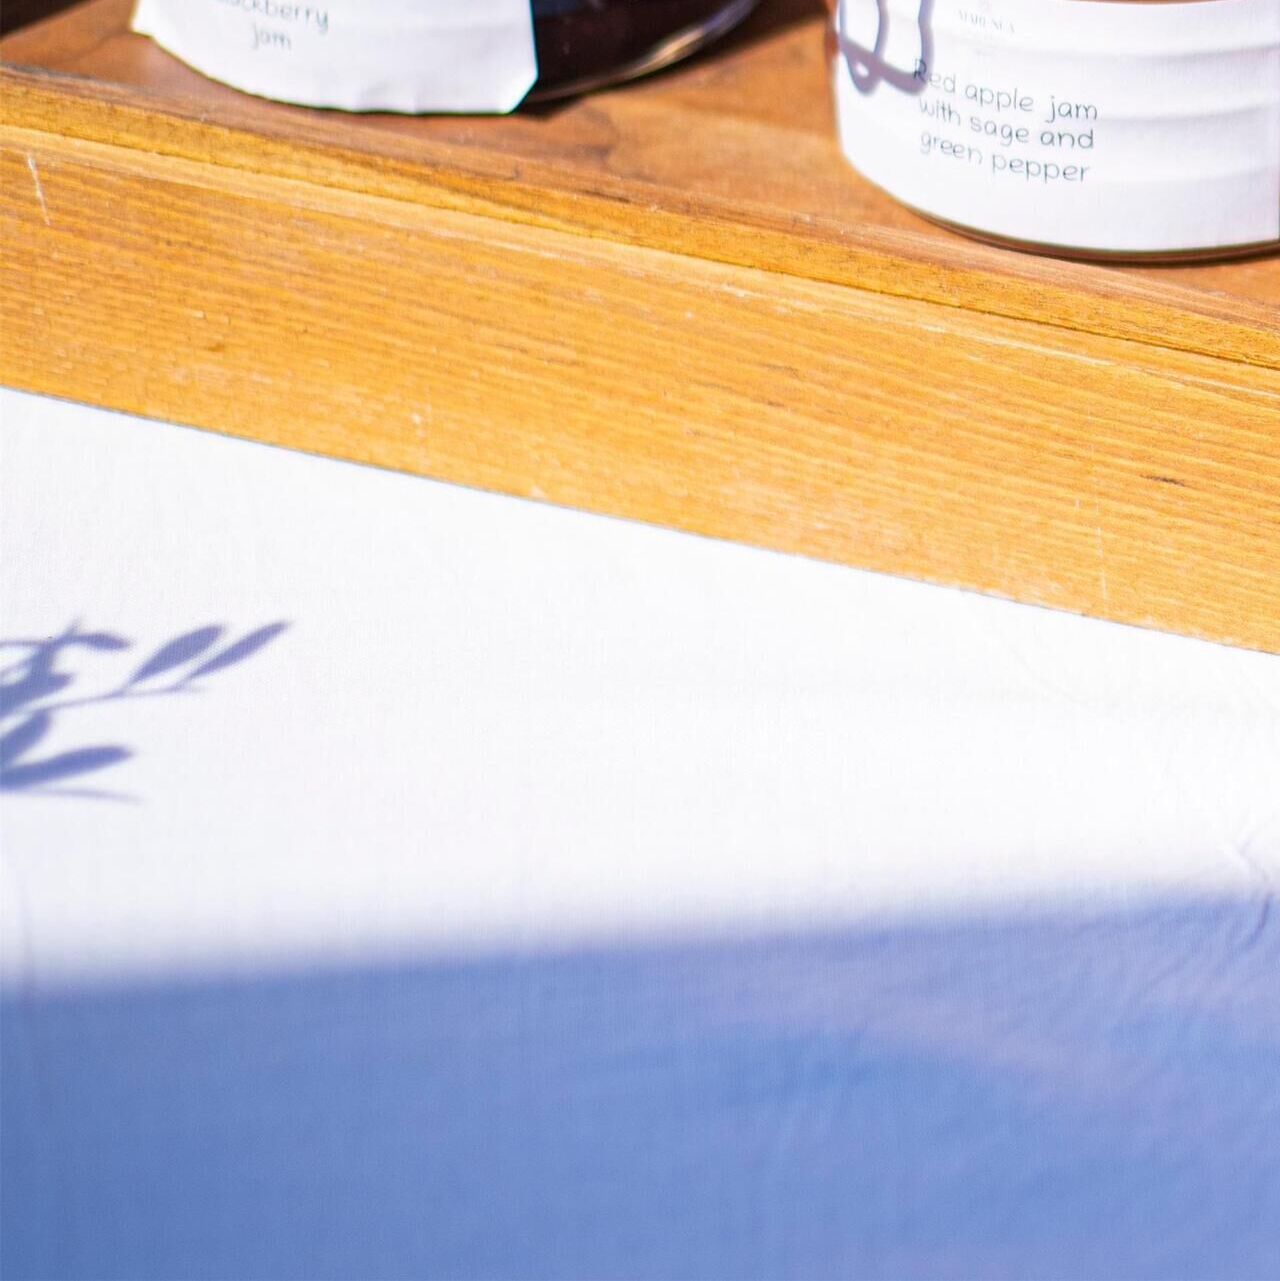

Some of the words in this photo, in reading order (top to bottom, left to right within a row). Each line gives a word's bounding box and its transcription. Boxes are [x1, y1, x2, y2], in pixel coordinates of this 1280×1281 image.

[252, 23, 291, 49] jam
[913, 57, 957, 95] Red
[964, 81, 1035, 115] apple
[1045, 94, 1098, 123] jam
[918, 94, 962, 128] with
[969, 114, 1030, 146] sage
[1039, 127, 1095, 150] and
[919, 130, 983, 165] green
[991, 151, 1091, 185] pepper
